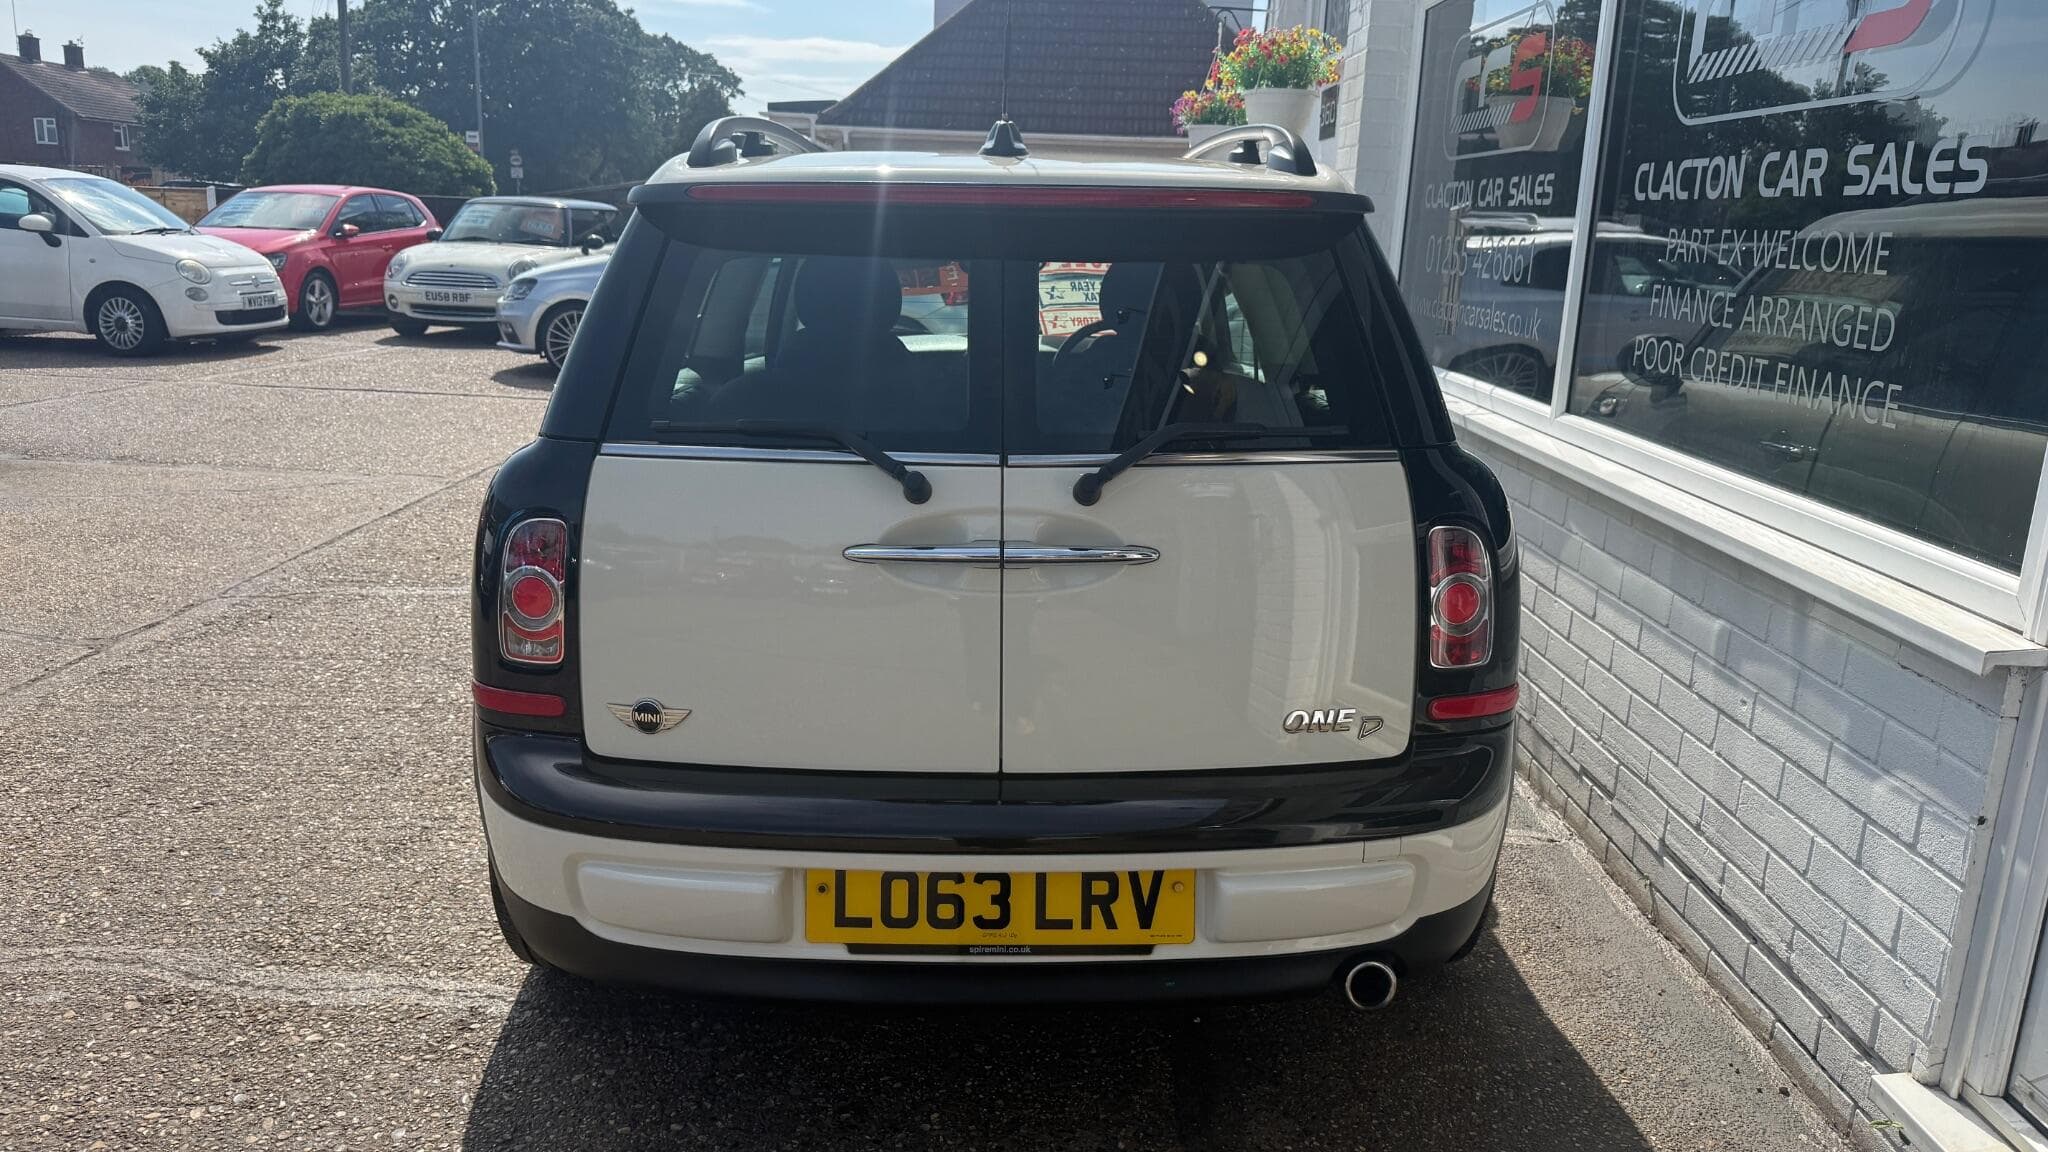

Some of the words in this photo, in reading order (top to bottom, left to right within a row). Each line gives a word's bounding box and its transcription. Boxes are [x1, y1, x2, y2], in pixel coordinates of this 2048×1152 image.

[1425, 180, 1474, 209] CLACTON
[1477, 177, 1504, 208] CAR
[1508, 173, 1556, 207] SALES
[1634, 154, 1748, 201] CLACTON
[1758, 147, 1828, 198] CAR
[1843, 138, 1991, 197] SALES
[1472, 236, 1537, 284] 426661
[1666, 228, 1715, 265] PART
[1717, 229, 1748, 267] EX
[1752, 229, 1894, 276] WELCOME
[1650, 284, 1737, 330] FINANCE
[1739, 295, 1896, 352] ARRANGED
[1633, 335, 1685, 378] POOR
[1690, 346, 1769, 395] CREDIT
[1774, 362, 1903, 429] FINANCE
[635, 712, 660, 723] MINI
[1283, 708, 1357, 734] ONE
[835, 870, 1012, 930] LO63
[1035, 870, 1165, 930] LRV
[969, 945, 1032, 955] spiremini.co.uk
